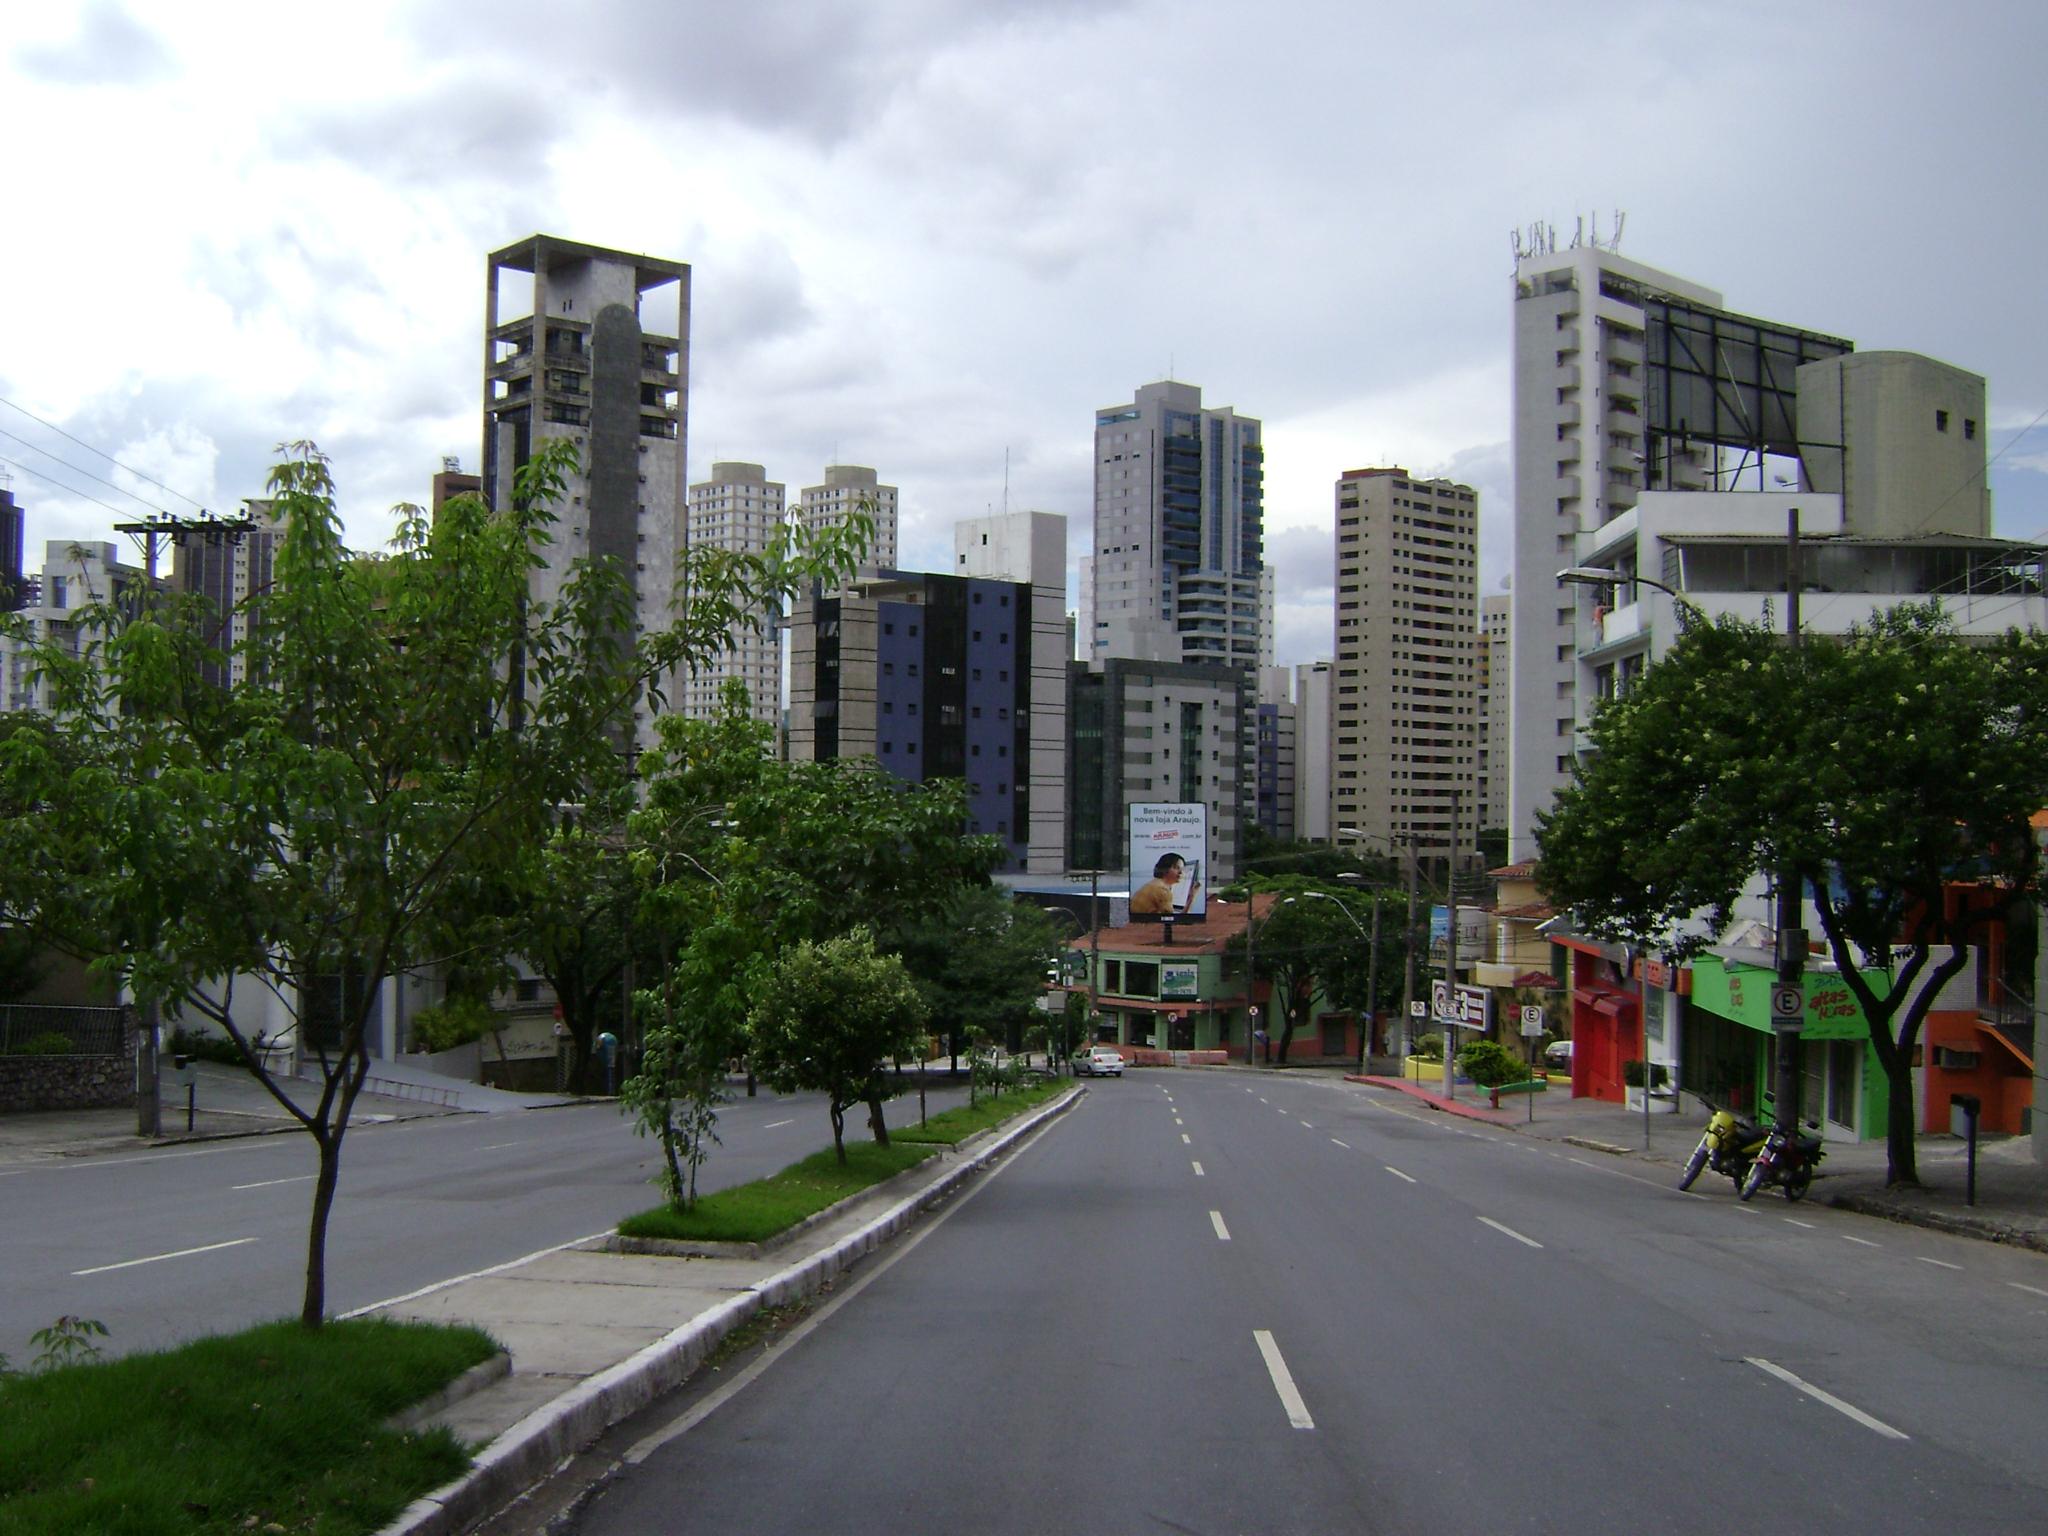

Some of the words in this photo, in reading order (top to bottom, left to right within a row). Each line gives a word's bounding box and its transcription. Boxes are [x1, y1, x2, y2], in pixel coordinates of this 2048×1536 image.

[1143, 807, 1186, 815] Bem-vindo
[1155, 816, 1171, 825] loja
[1782, 993, 1793, 1010] E
[1528, 1010, 1535, 1020] E
